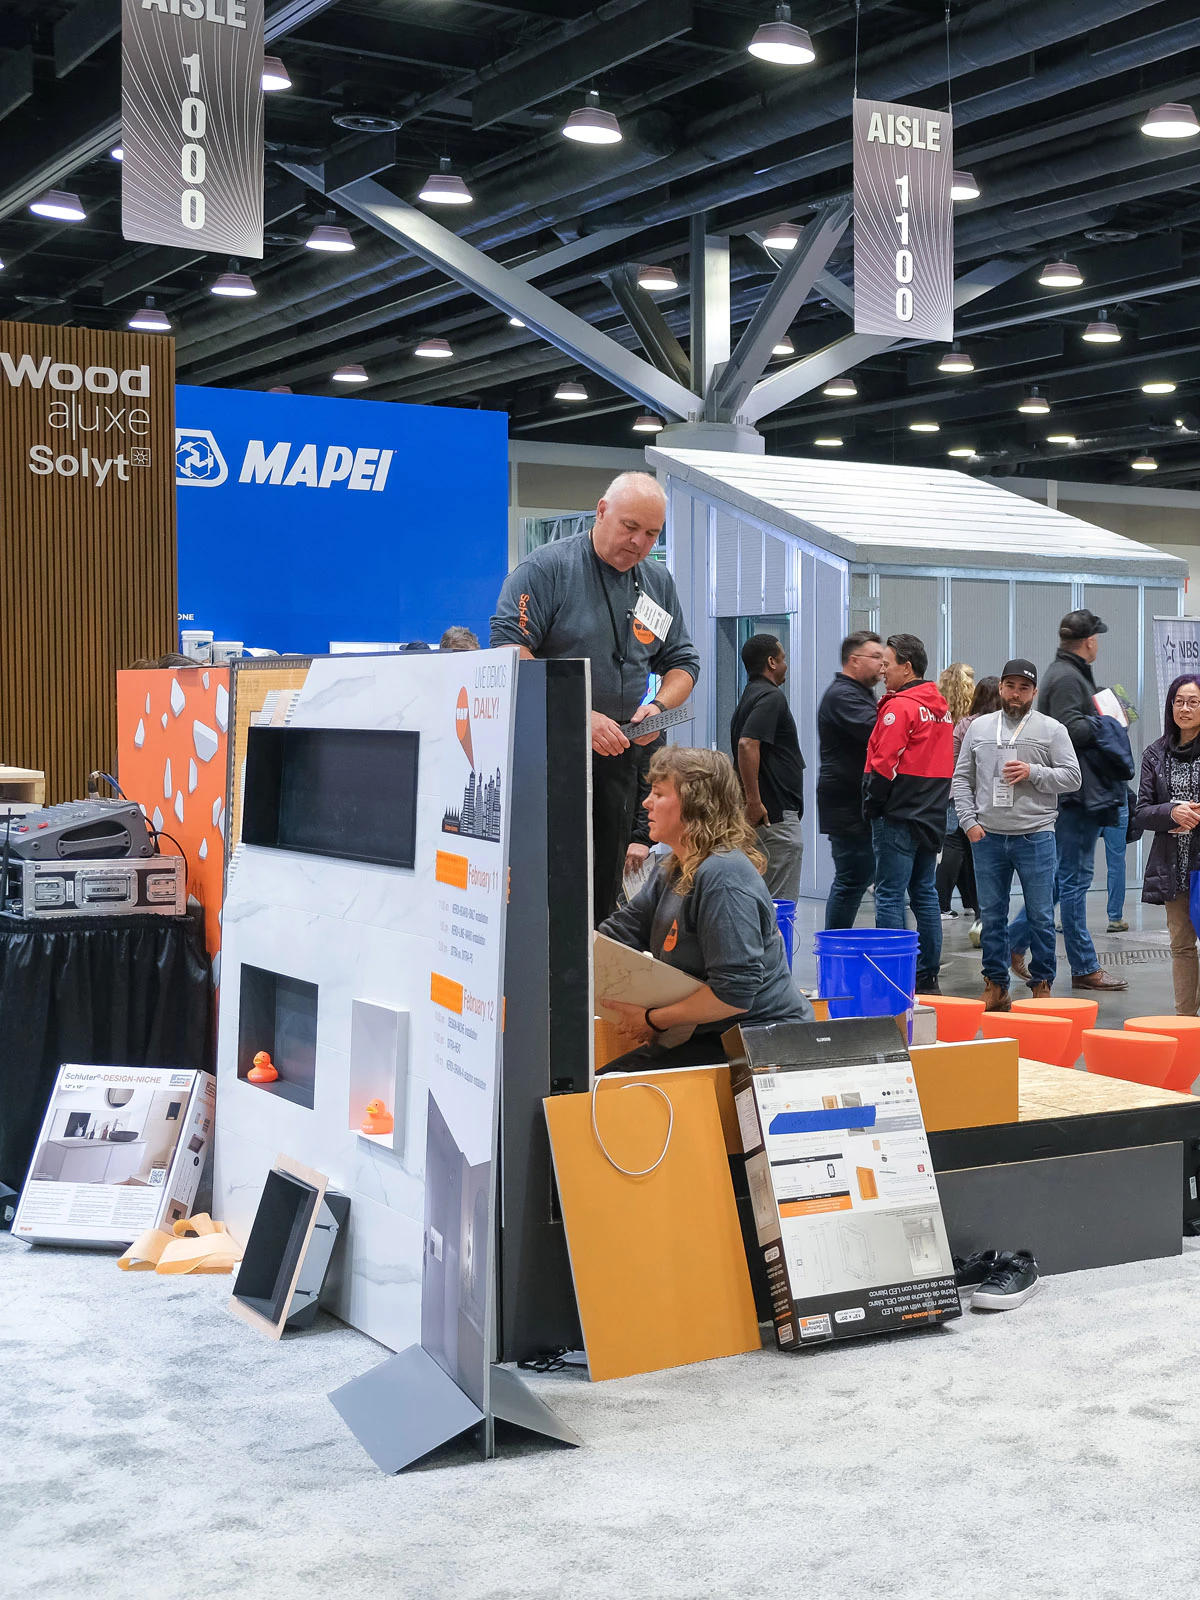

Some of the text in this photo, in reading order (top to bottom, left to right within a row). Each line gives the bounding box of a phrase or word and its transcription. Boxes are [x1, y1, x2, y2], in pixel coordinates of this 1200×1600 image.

[182, 53, 206, 230] 1000
[867, 112, 941, 152] AISLE
[895, 174, 914, 322] 1100
[0, 352, 150, 398] Wood
[48, 393, 150, 441] aluxe
[28, 445, 130, 487] Solyt
[238, 440, 394, 492] MAPEI
[1179, 640, 1199, 659] NBS
[474, 665, 507, 689] LIVE DEMOS
[474, 696, 500, 720] DAILY!
[468, 863, 499, 894] February 11
[463, 988, 494, 1023] February 12
[868, 1289, 888, 1297] blanco
[889, 1287, 900, 1295] LED
[912, 1292, 932, 1300] douche
[914, 1282, 930, 1290] ducha
[881, 1307, 894, 1315] LED
[894, 1304, 909, 1312] white
[937, 1297, 959, 1305] Shower
